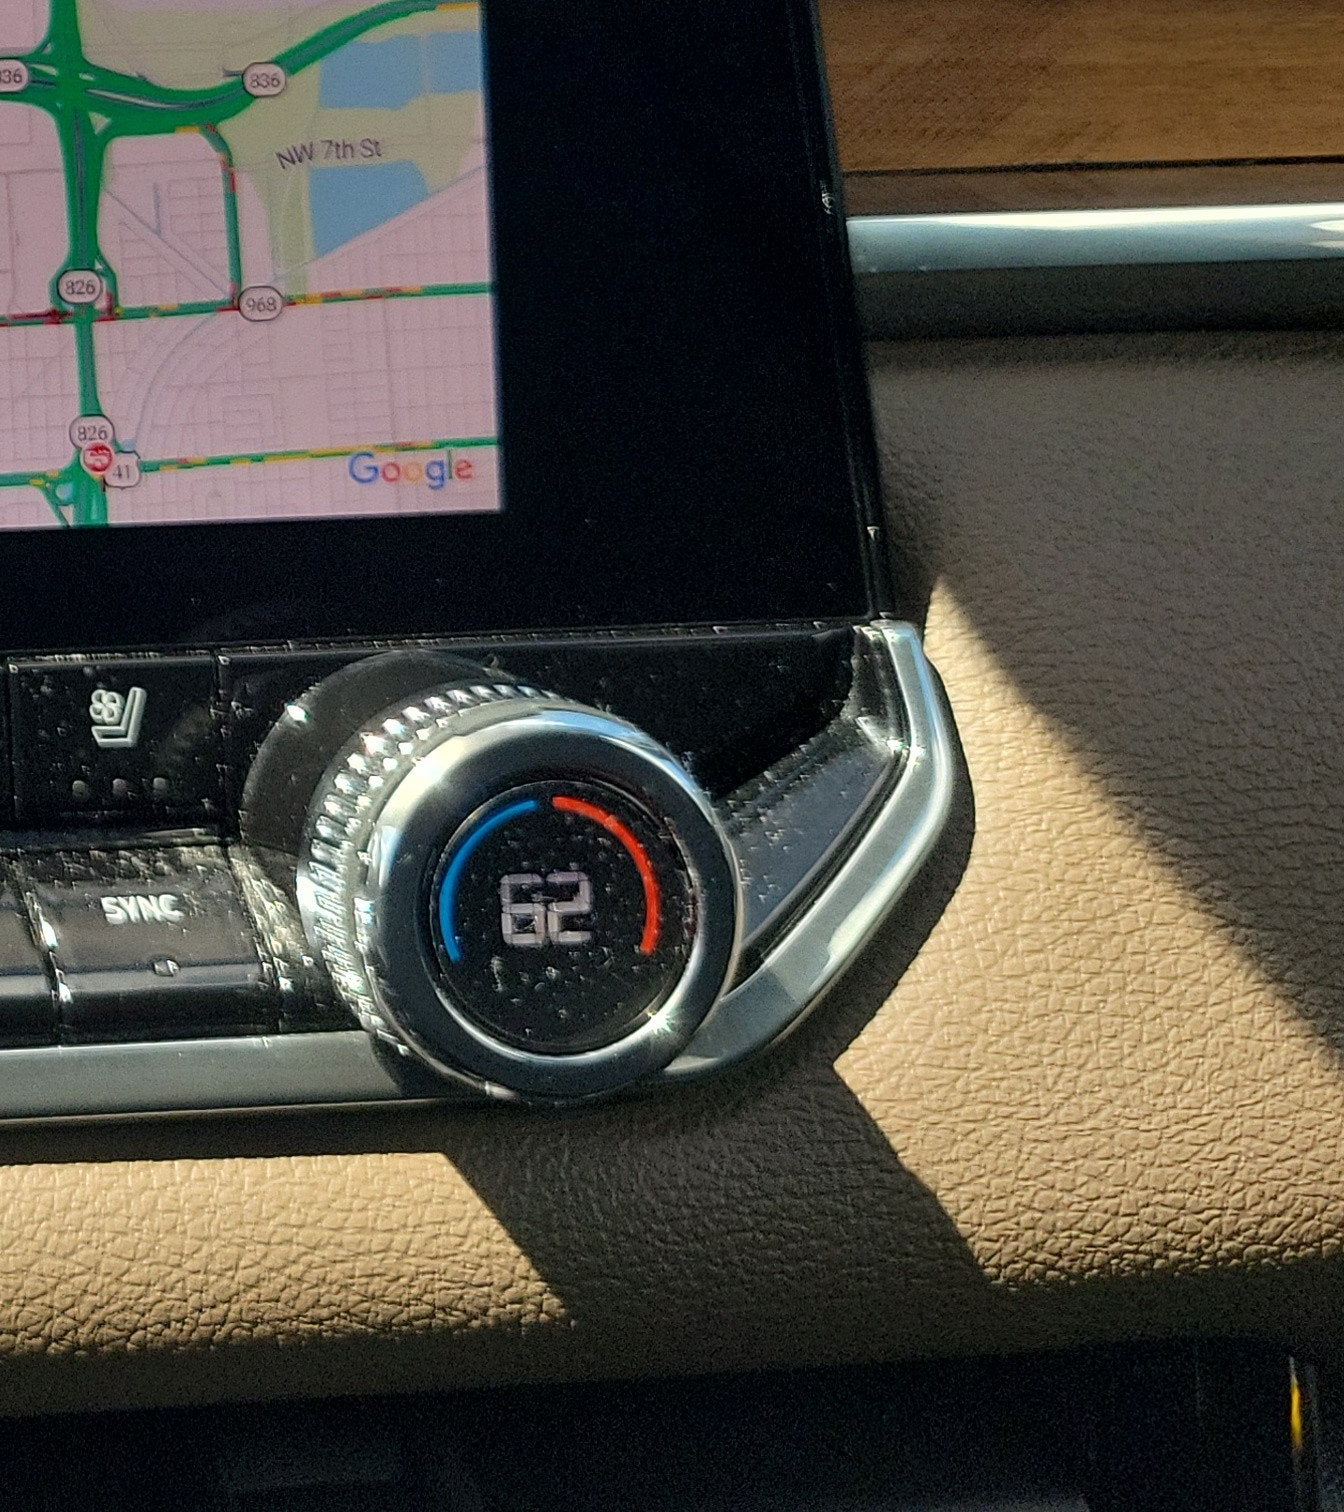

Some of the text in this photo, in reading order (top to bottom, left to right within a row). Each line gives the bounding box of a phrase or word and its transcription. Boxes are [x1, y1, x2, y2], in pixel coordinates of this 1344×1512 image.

[249, 72, 279, 88] 836
[276, 139, 382, 170] NW 7th St
[63, 279, 96, 296] 826
[247, 296, 277, 313] 968
[76, 425, 107, 441] 826
[349, 452, 474, 489] Google
[102, 894, 181, 925] SYNC
[499, 873, 593, 948] 62
